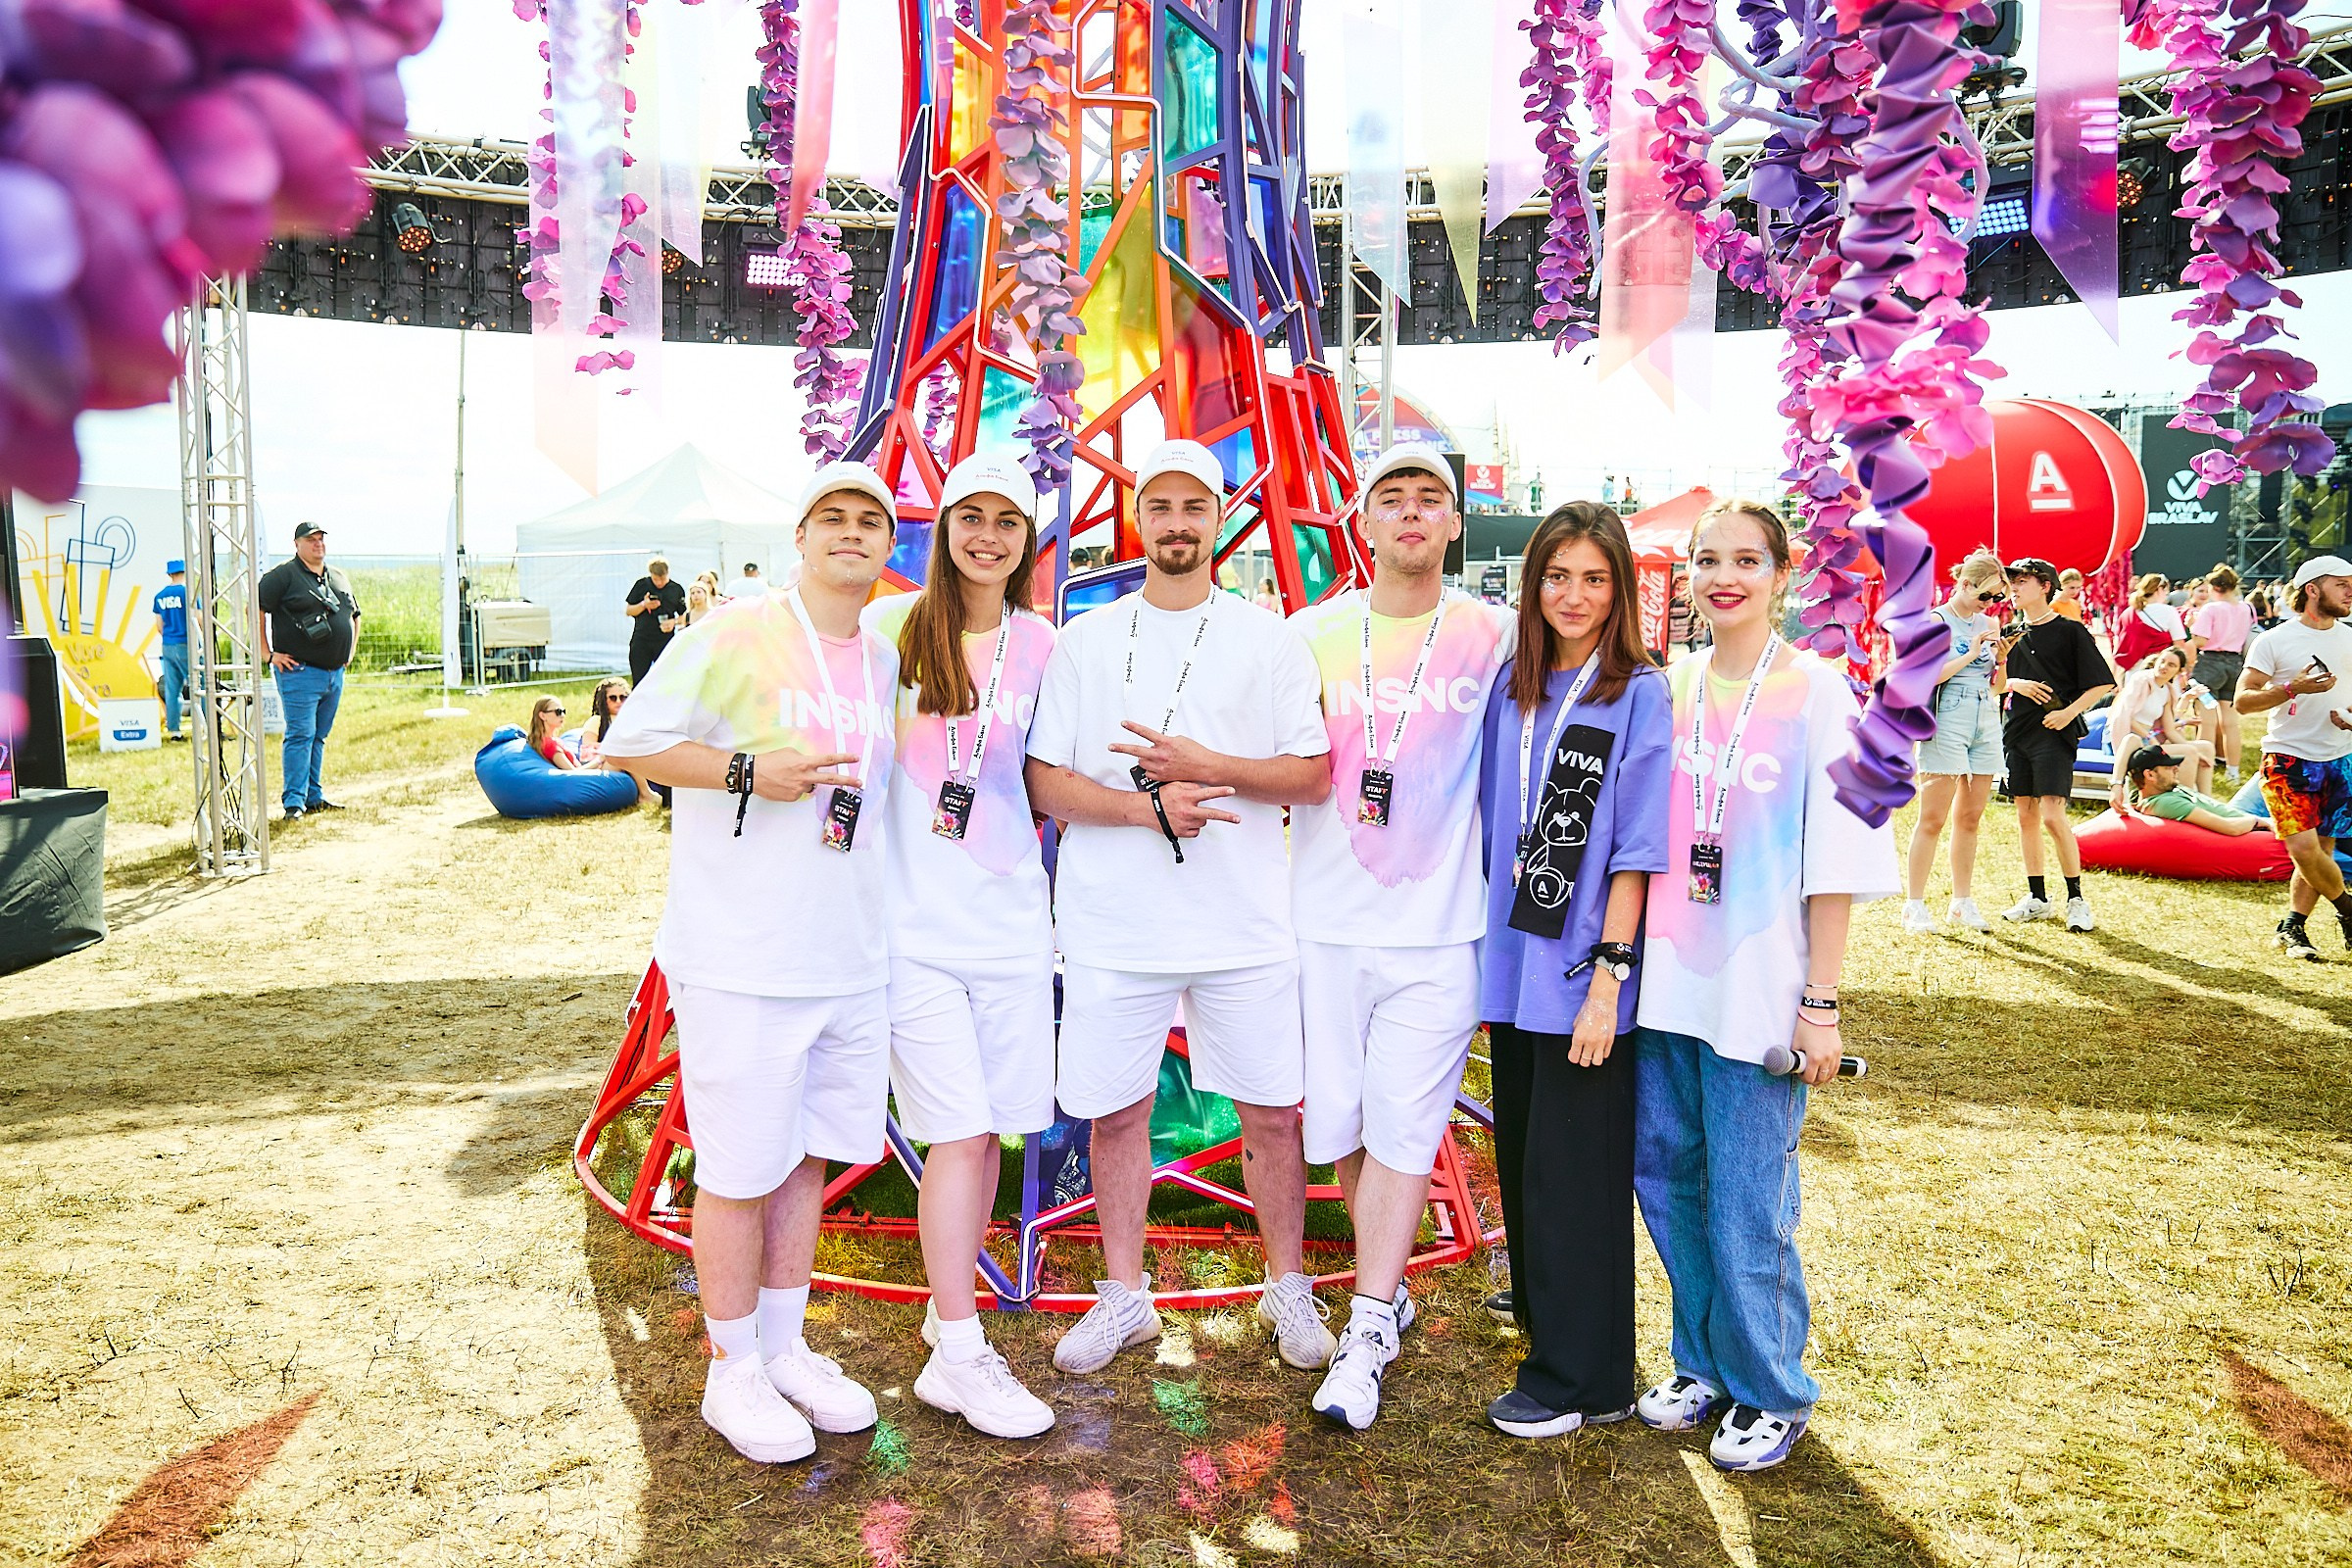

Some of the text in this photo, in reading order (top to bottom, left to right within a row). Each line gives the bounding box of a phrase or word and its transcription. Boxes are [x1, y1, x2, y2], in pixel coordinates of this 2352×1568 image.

[1372, 428, 1421, 441] PESS
[2164, 501, 2203, 513] VIVA
[2148, 512, 2220, 524] BRASLAV
[157, 596, 182, 610] VISA
[1638, 566, 1666, 649] oca-Cola
[1572, 679, 1584, 692] VISA
[1326, 676, 1480, 716] INSNC
[120, 730, 140, 739] Extra
[1557, 748, 1604, 775] VIVA
[1365, 785, 1389, 795] STAFF
[944, 796, 969, 808] STAFF
[834, 805, 857, 817] STAFF
